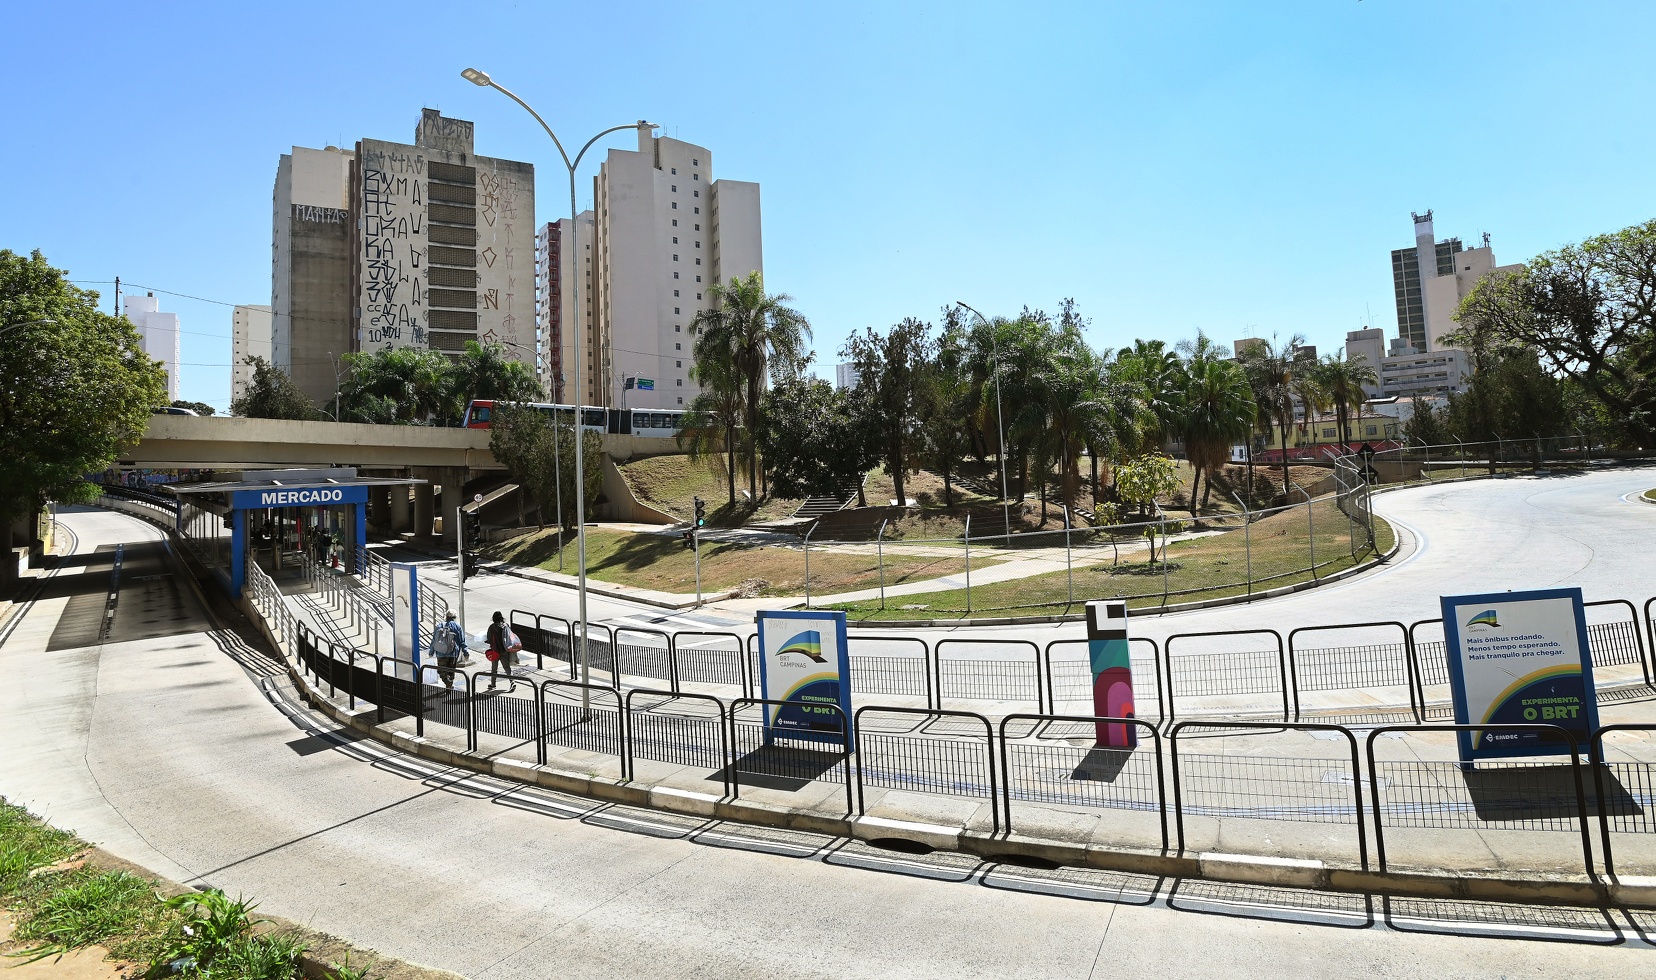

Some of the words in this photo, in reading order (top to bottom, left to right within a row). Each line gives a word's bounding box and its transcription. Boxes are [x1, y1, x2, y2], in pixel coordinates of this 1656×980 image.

[261, 490, 342, 504] MERCADO
[1486, 651, 1520, 660] tranquilo
[801, 695, 837, 704] EXPERIMENTA
[1522, 696, 1579, 706] EXPERIMENTA
[1523, 707, 1538, 720] O
[1542, 706, 1580, 720] BRT
